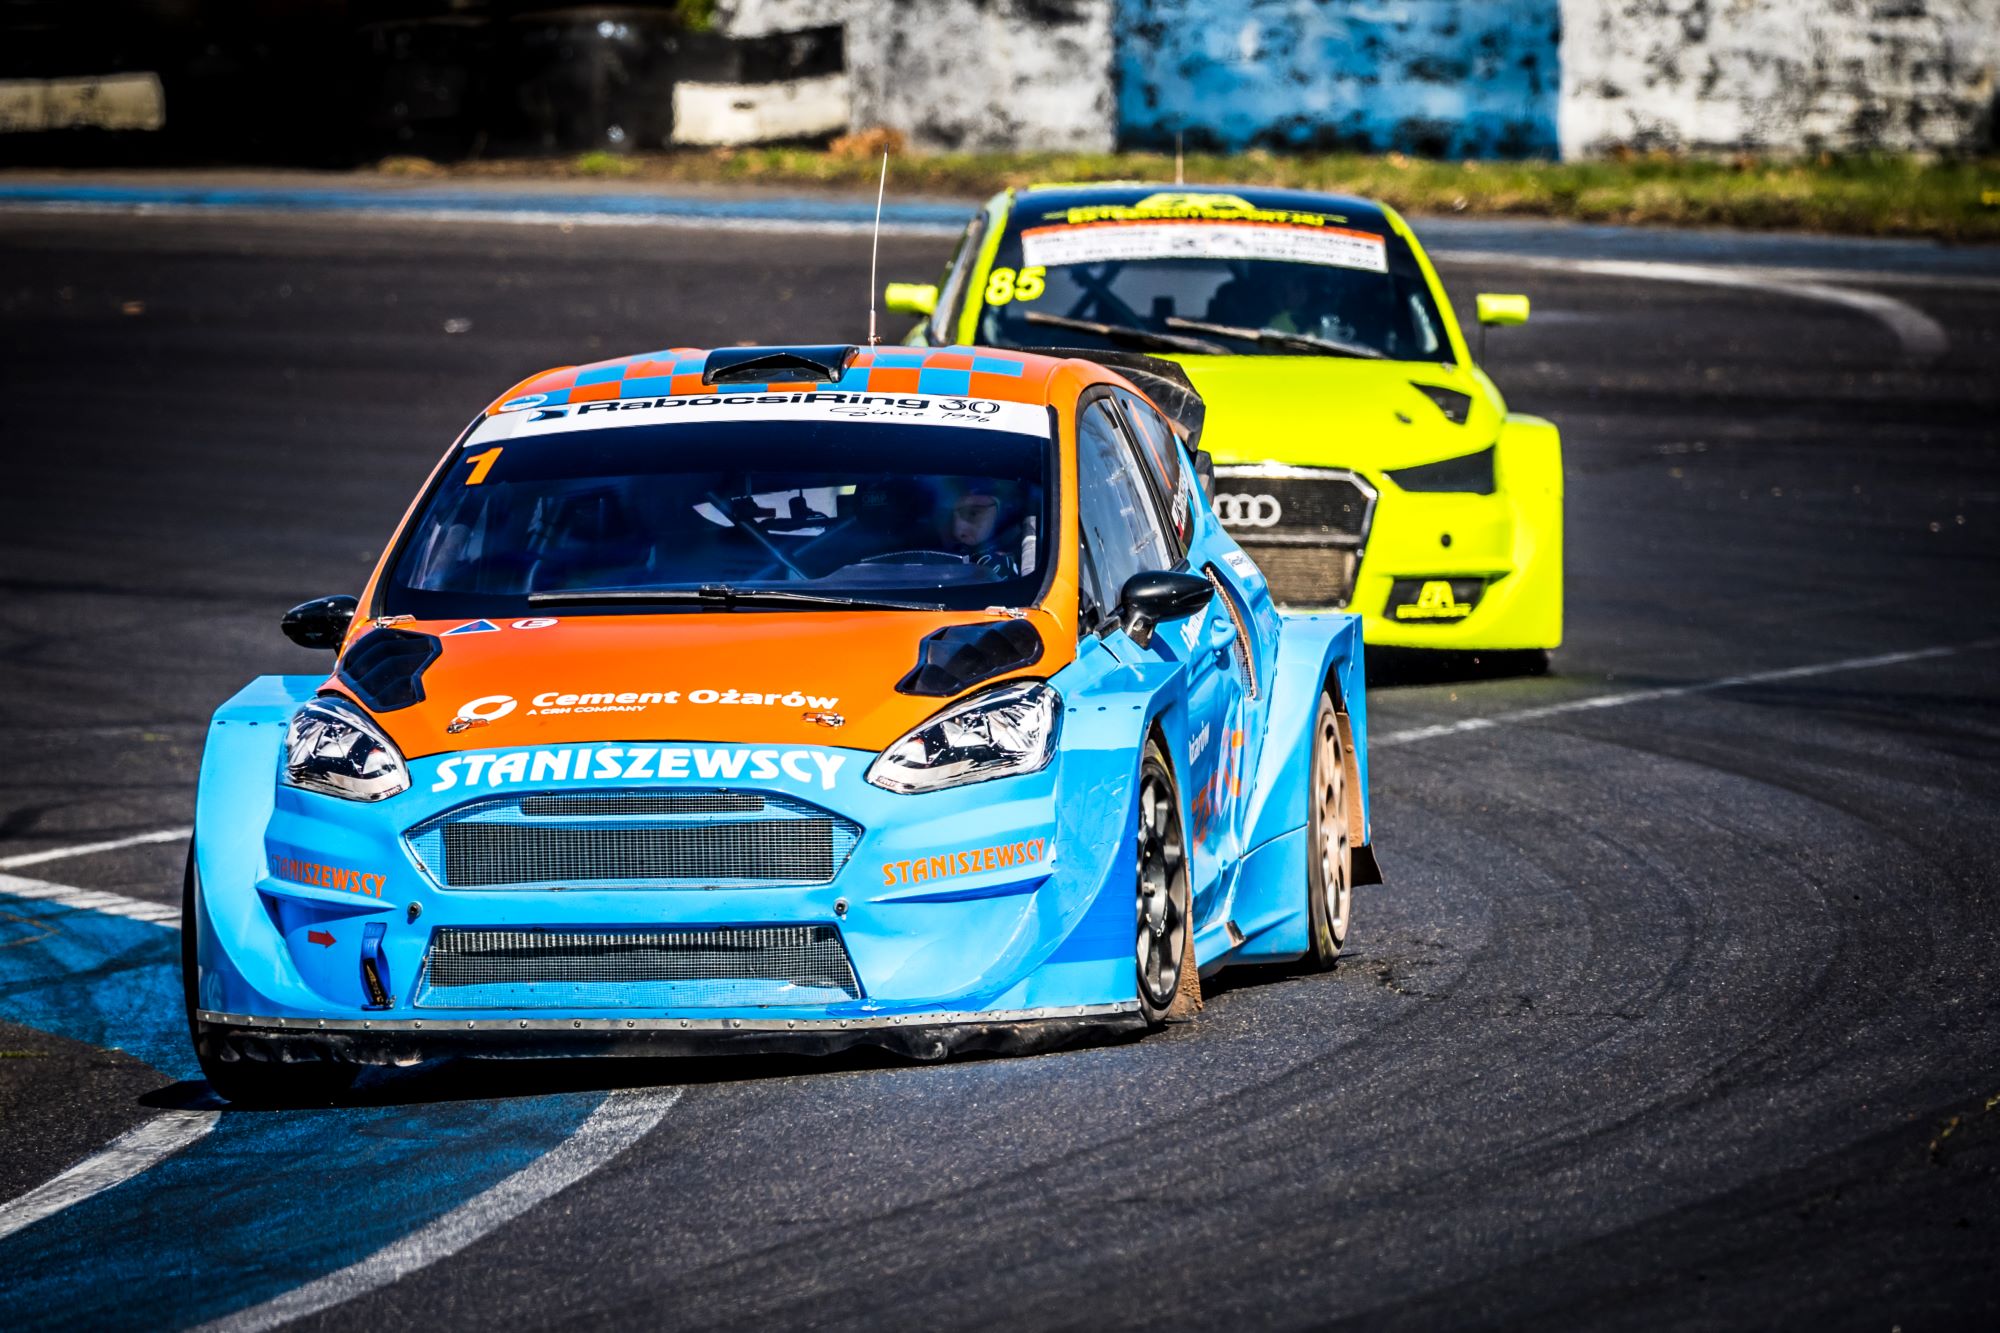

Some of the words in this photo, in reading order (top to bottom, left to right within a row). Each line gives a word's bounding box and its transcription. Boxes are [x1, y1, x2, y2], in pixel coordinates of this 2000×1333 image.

[985, 265, 1047, 306] 85
[577, 393, 930, 415] RabócsiRing
[939, 398, 1001, 414] 30
[830, 406, 924, 417] Since
[941, 412, 990, 423] 1996
[466, 447, 503, 485] 1
[532, 691, 681, 707] Cement
[688, 689, 839, 710] Ożarów
[541, 707, 572, 715] CRH
[574, 705, 647, 713] COMPANY
[432, 749, 846, 793] STANISZEWSCY
[272, 853, 387, 899] STANISZEWSCY
[882, 837, 1046, 886] STANISZEWSCY
